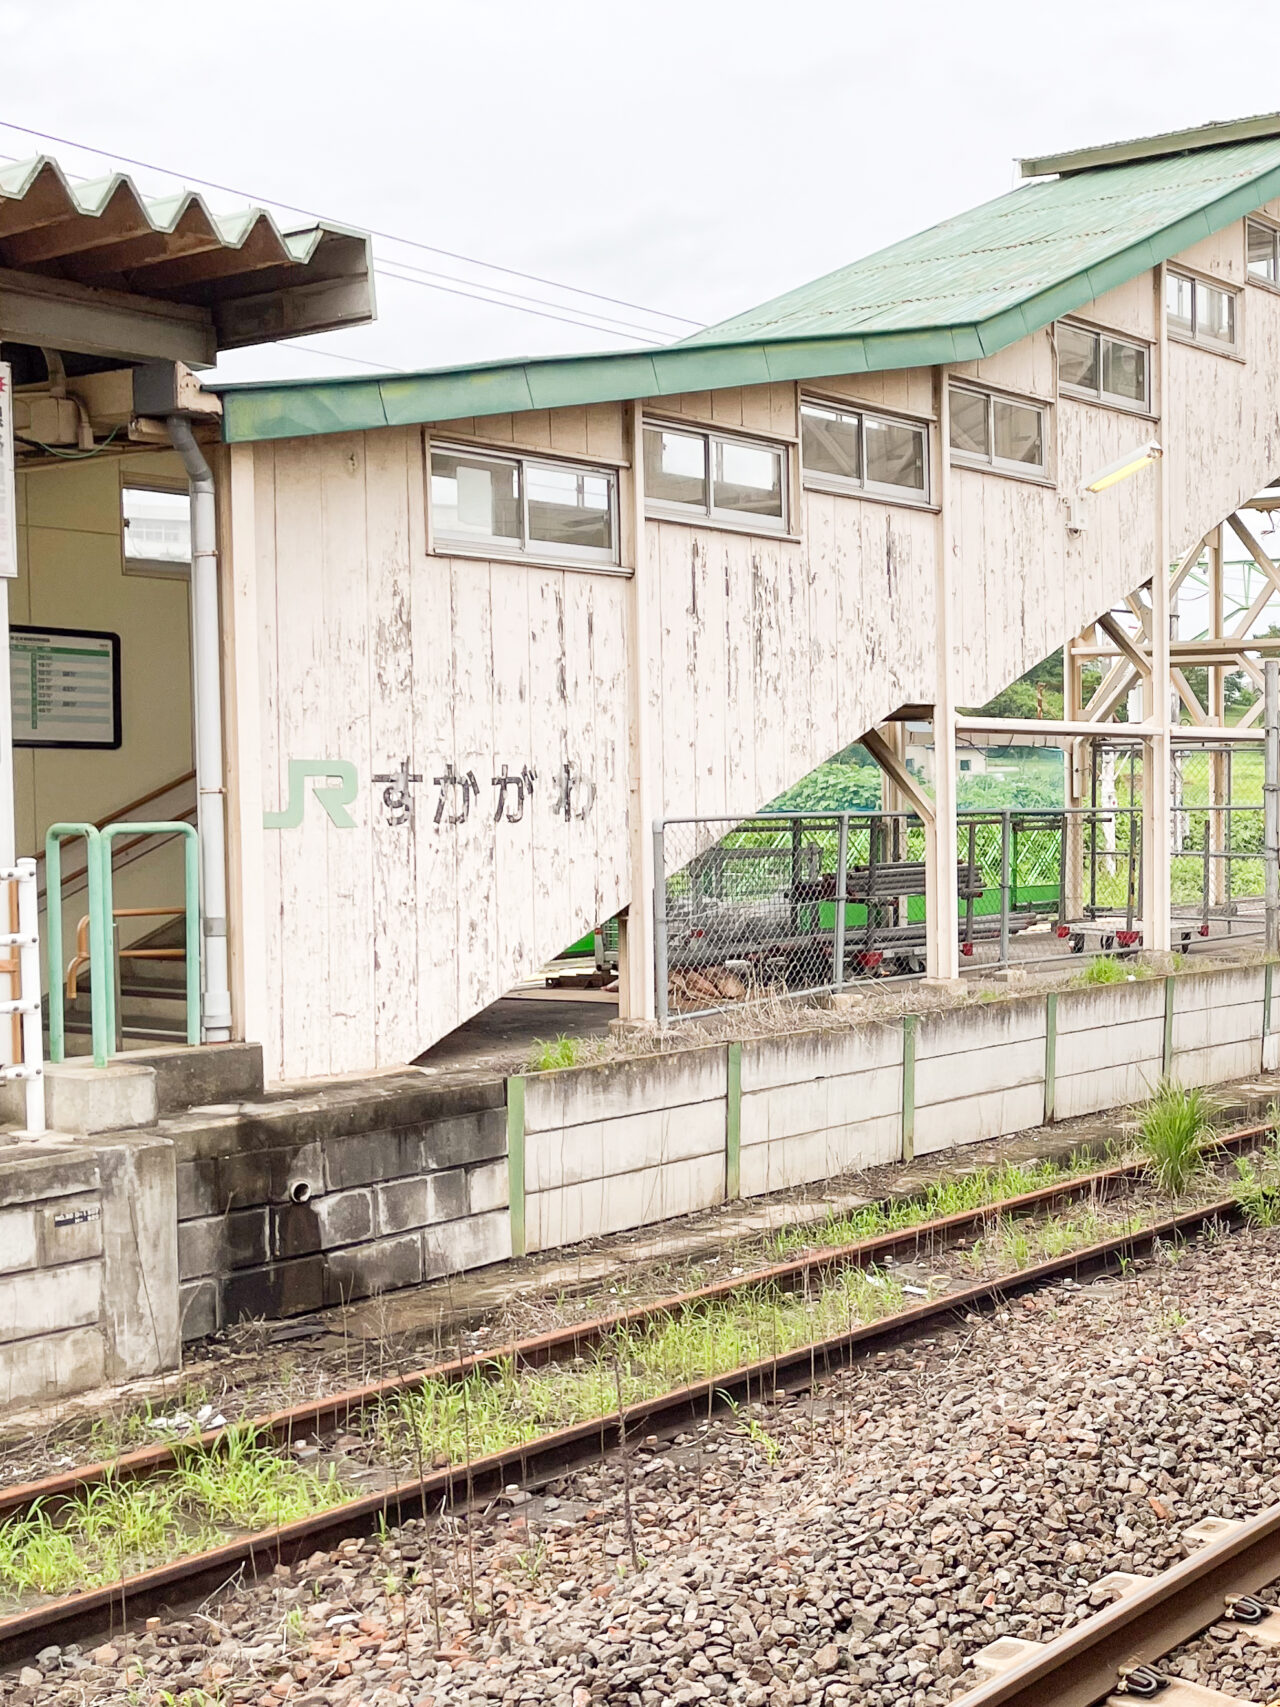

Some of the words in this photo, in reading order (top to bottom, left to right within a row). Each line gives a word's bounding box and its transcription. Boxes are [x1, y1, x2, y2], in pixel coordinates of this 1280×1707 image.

[263, 759, 358, 828] JR
[371, 761, 597, 827] すかがわ
